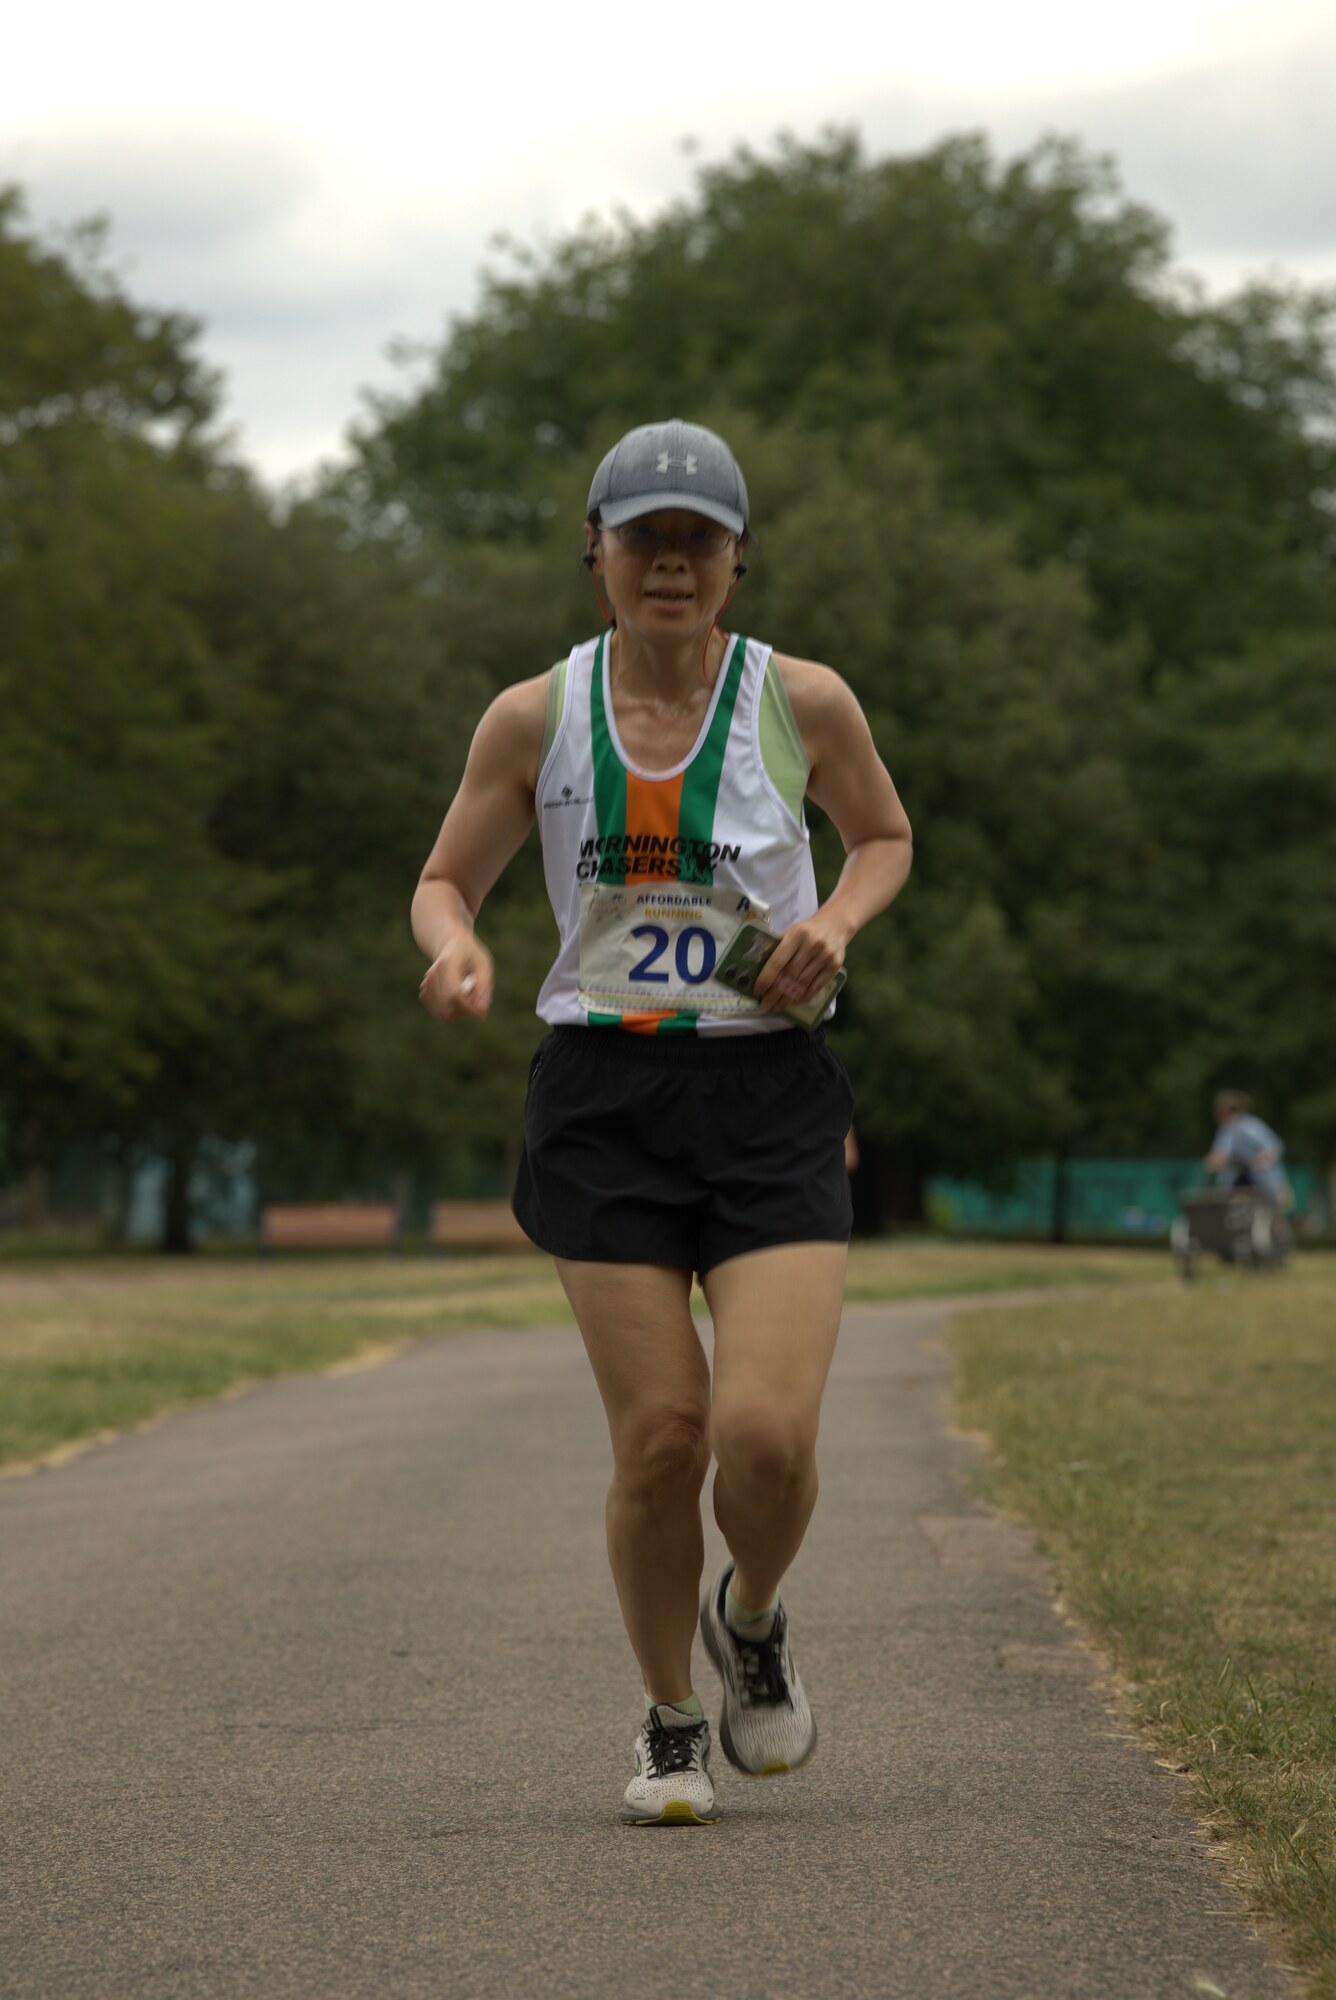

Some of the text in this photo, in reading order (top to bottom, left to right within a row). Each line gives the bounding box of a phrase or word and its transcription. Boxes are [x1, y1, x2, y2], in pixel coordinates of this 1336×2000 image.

[636, 895, 712, 907] AFFORDABLE
[645, 907, 703, 920] RUNNING
[628, 925, 717, 985] 20
